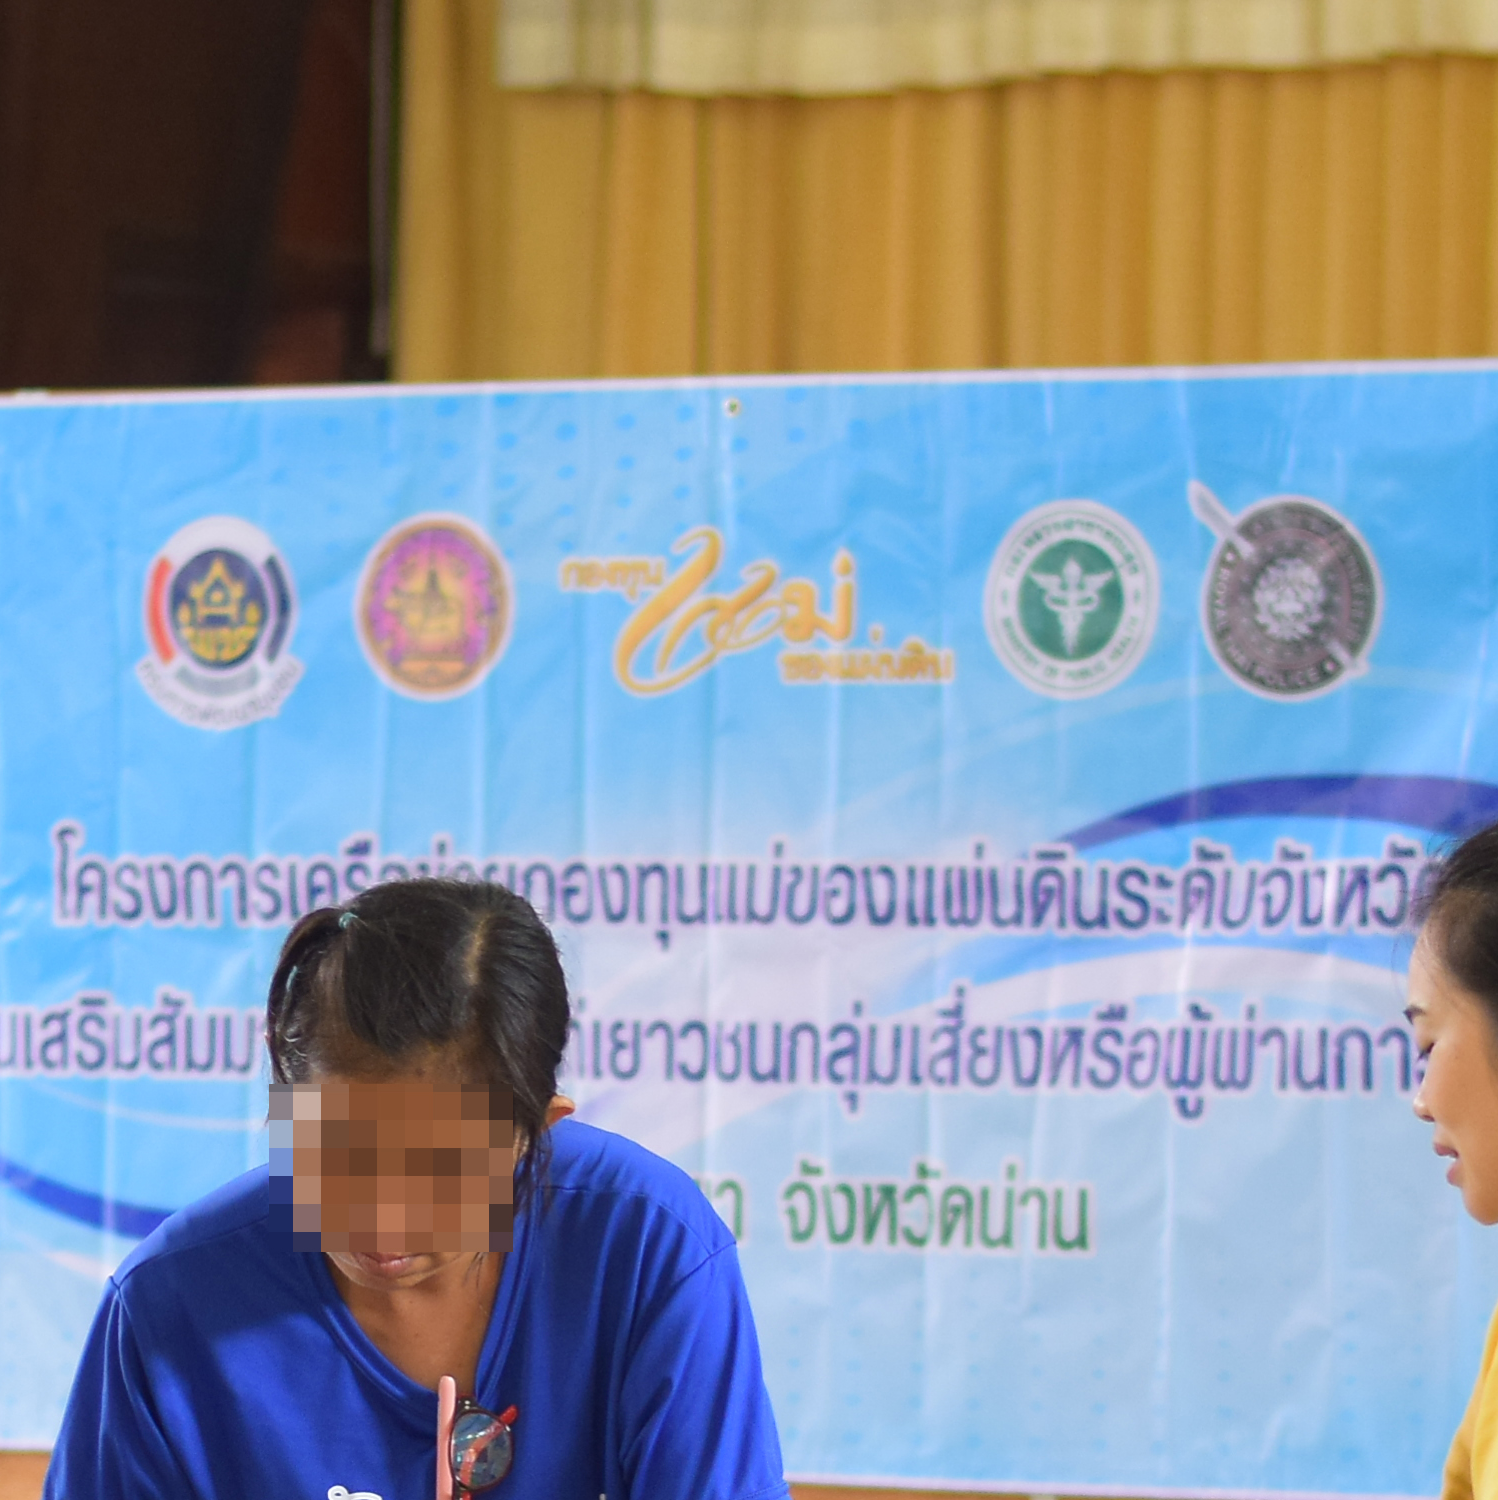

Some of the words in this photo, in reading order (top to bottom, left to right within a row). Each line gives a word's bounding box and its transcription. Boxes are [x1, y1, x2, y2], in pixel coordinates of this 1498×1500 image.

[782, 1158, 1091, 1253] จังหวัดน่าน
